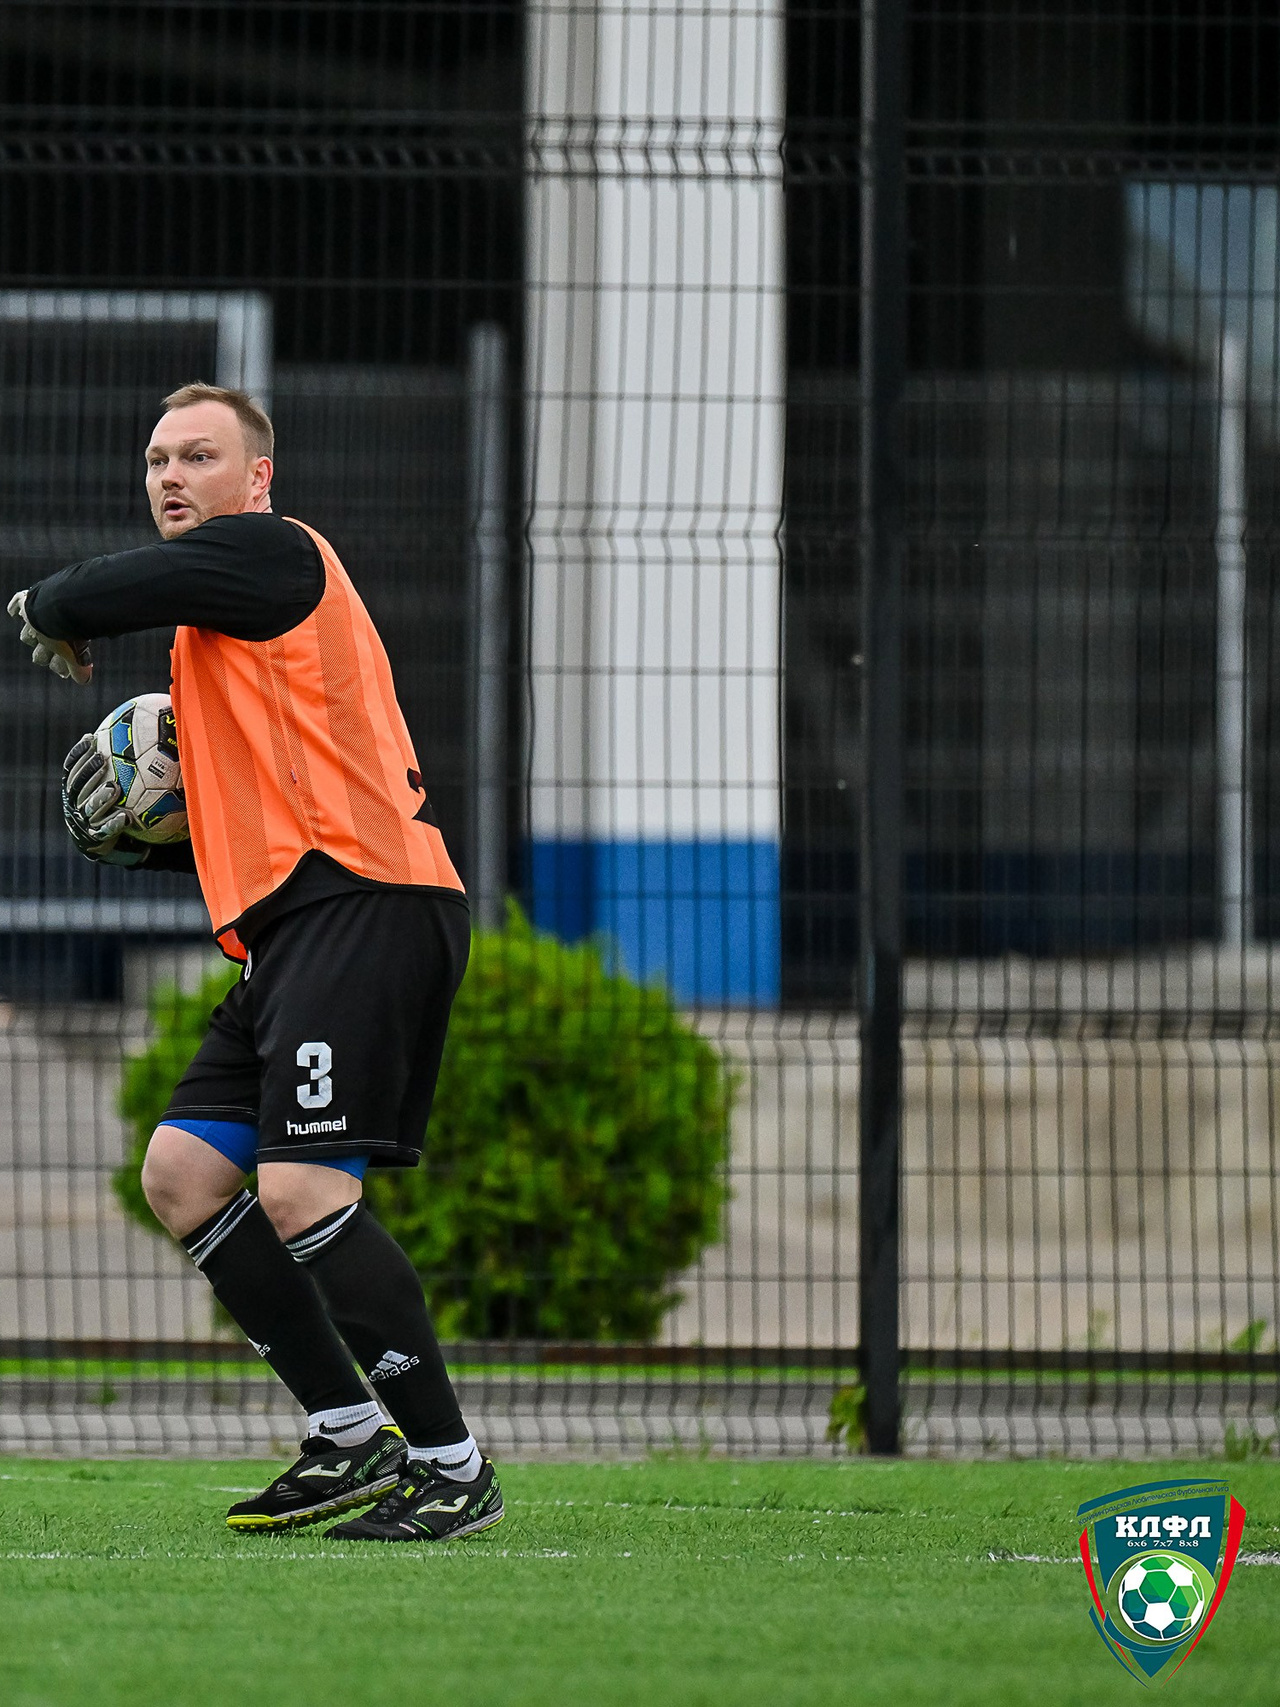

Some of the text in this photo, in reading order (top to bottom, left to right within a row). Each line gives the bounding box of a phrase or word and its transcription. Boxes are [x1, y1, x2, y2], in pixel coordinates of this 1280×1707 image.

[296, 1042, 333, 1110] 3
[286, 1116, 347, 1136] hummel
[368, 1354, 421, 1383] adidas
